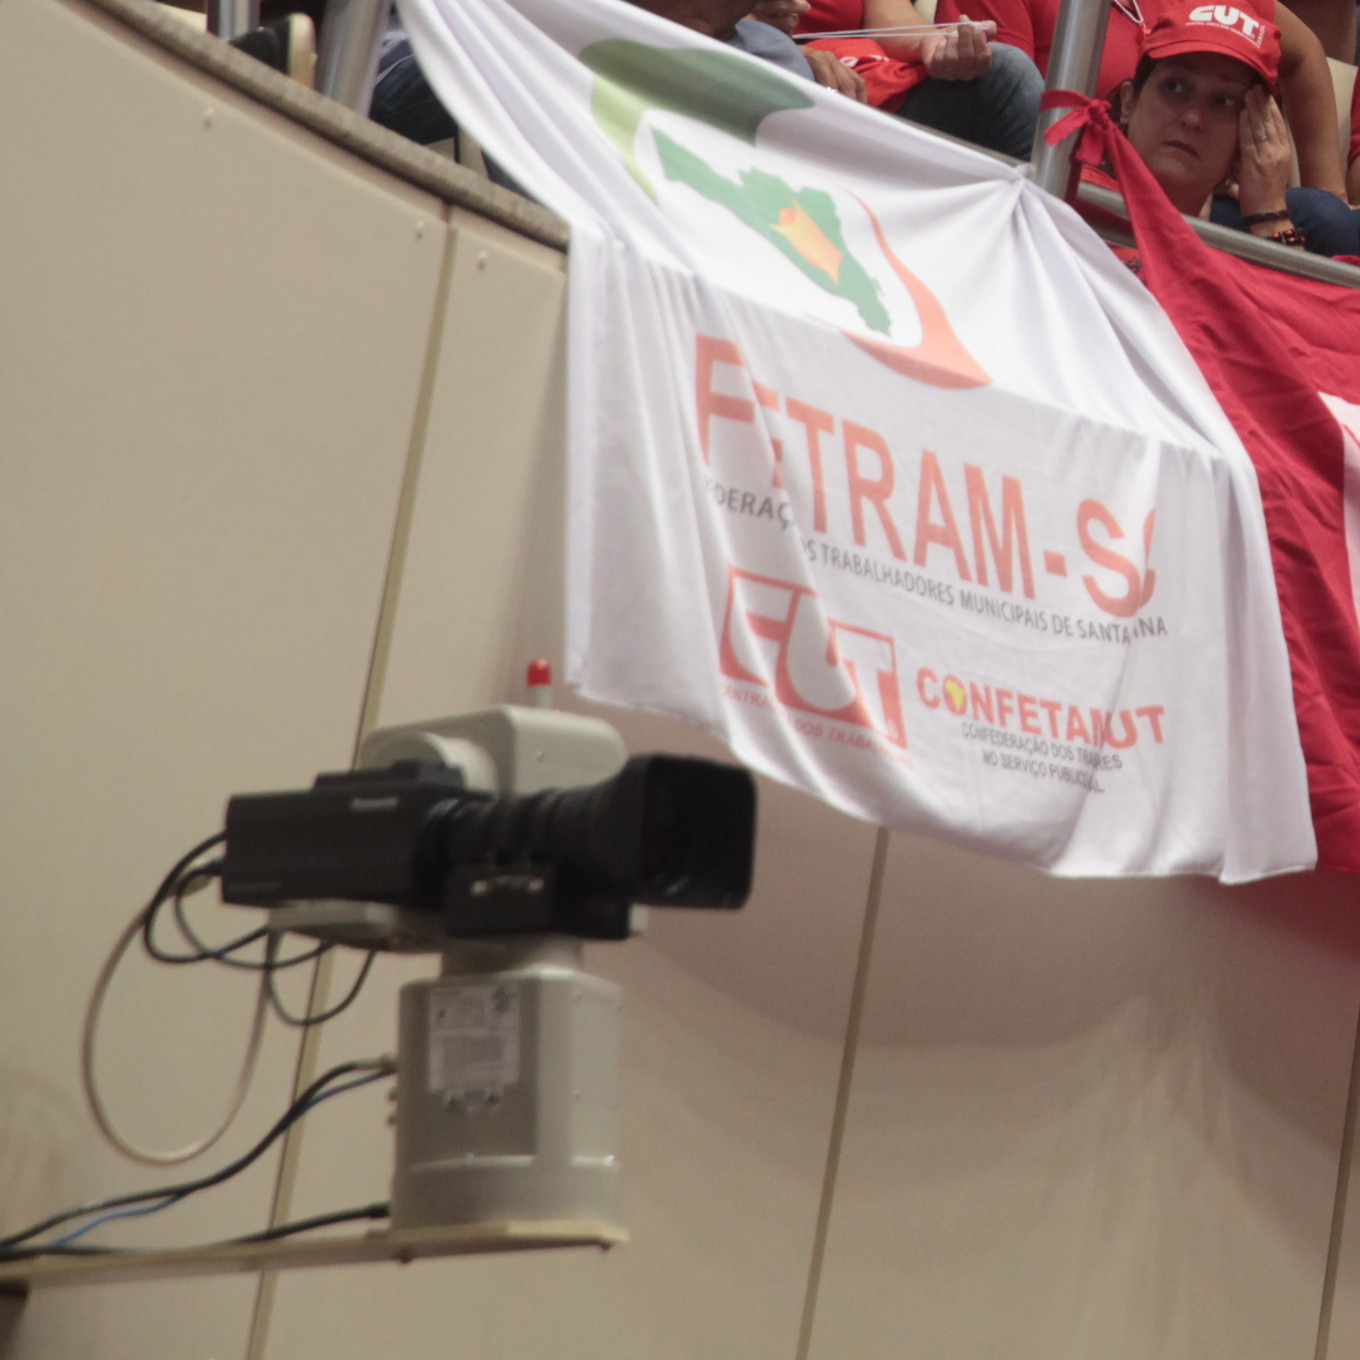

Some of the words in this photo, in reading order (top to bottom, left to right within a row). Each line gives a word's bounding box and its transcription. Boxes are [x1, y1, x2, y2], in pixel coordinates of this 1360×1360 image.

[1189, 5, 1260, 37] CUT
[821, 544, 954, 607] TRABALHADORES
[960, 589, 1048, 631] MUNICIPAIS
[1052, 614, 1074, 638] DE
[1078, 618, 1131, 646] SANTA
[961, 721, 1049, 756] CONFEDERAÇÃO
[1050, 742, 1075, 761] DOS
[982, 749, 999, 767] NO
[1000, 752, 1047, 779] SERVIÇO
